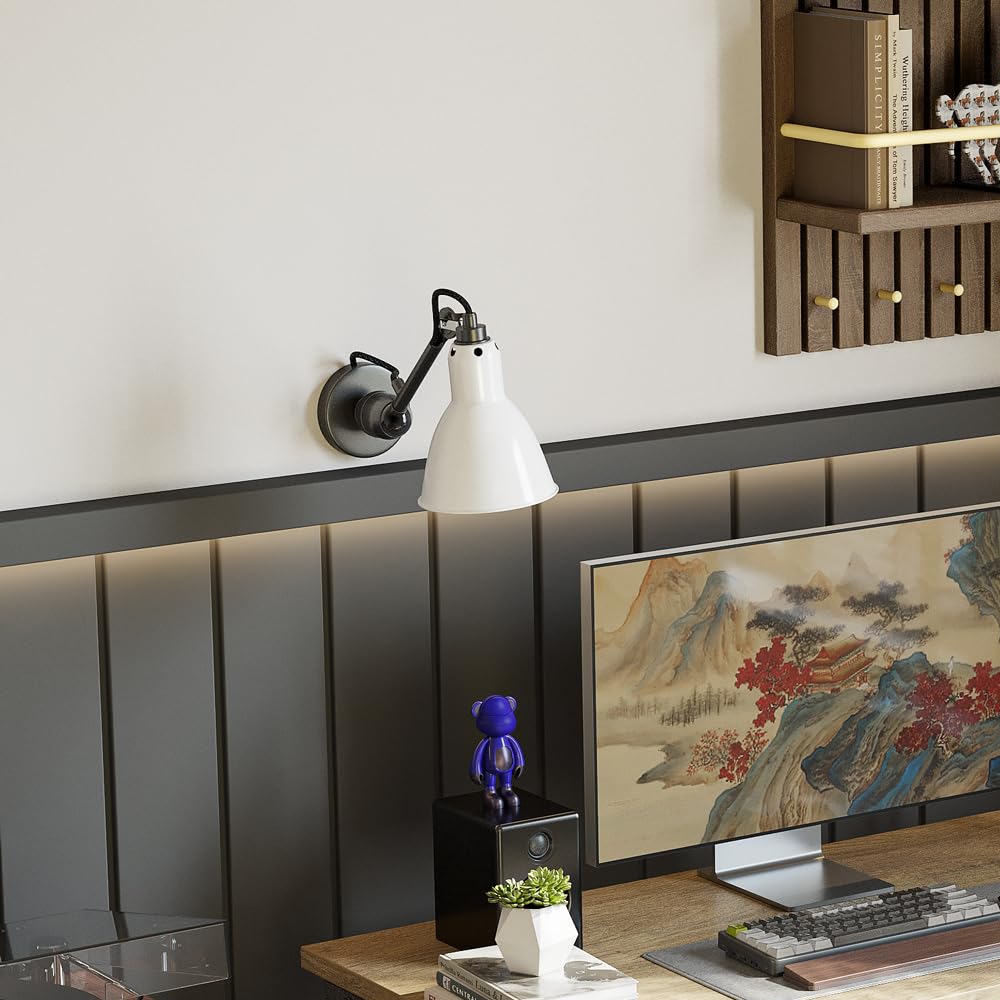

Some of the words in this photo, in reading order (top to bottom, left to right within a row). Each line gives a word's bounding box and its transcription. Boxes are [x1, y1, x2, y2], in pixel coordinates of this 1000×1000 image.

[874, 34, 883, 131] SIMPLICITY
[900, 55, 910, 102] Wuthering
[900, 104, 910, 133] Heigh
[892, 150, 898, 158] of
[475, 980, 491, 997] Luna
[492, 991, 499, 1000] &
